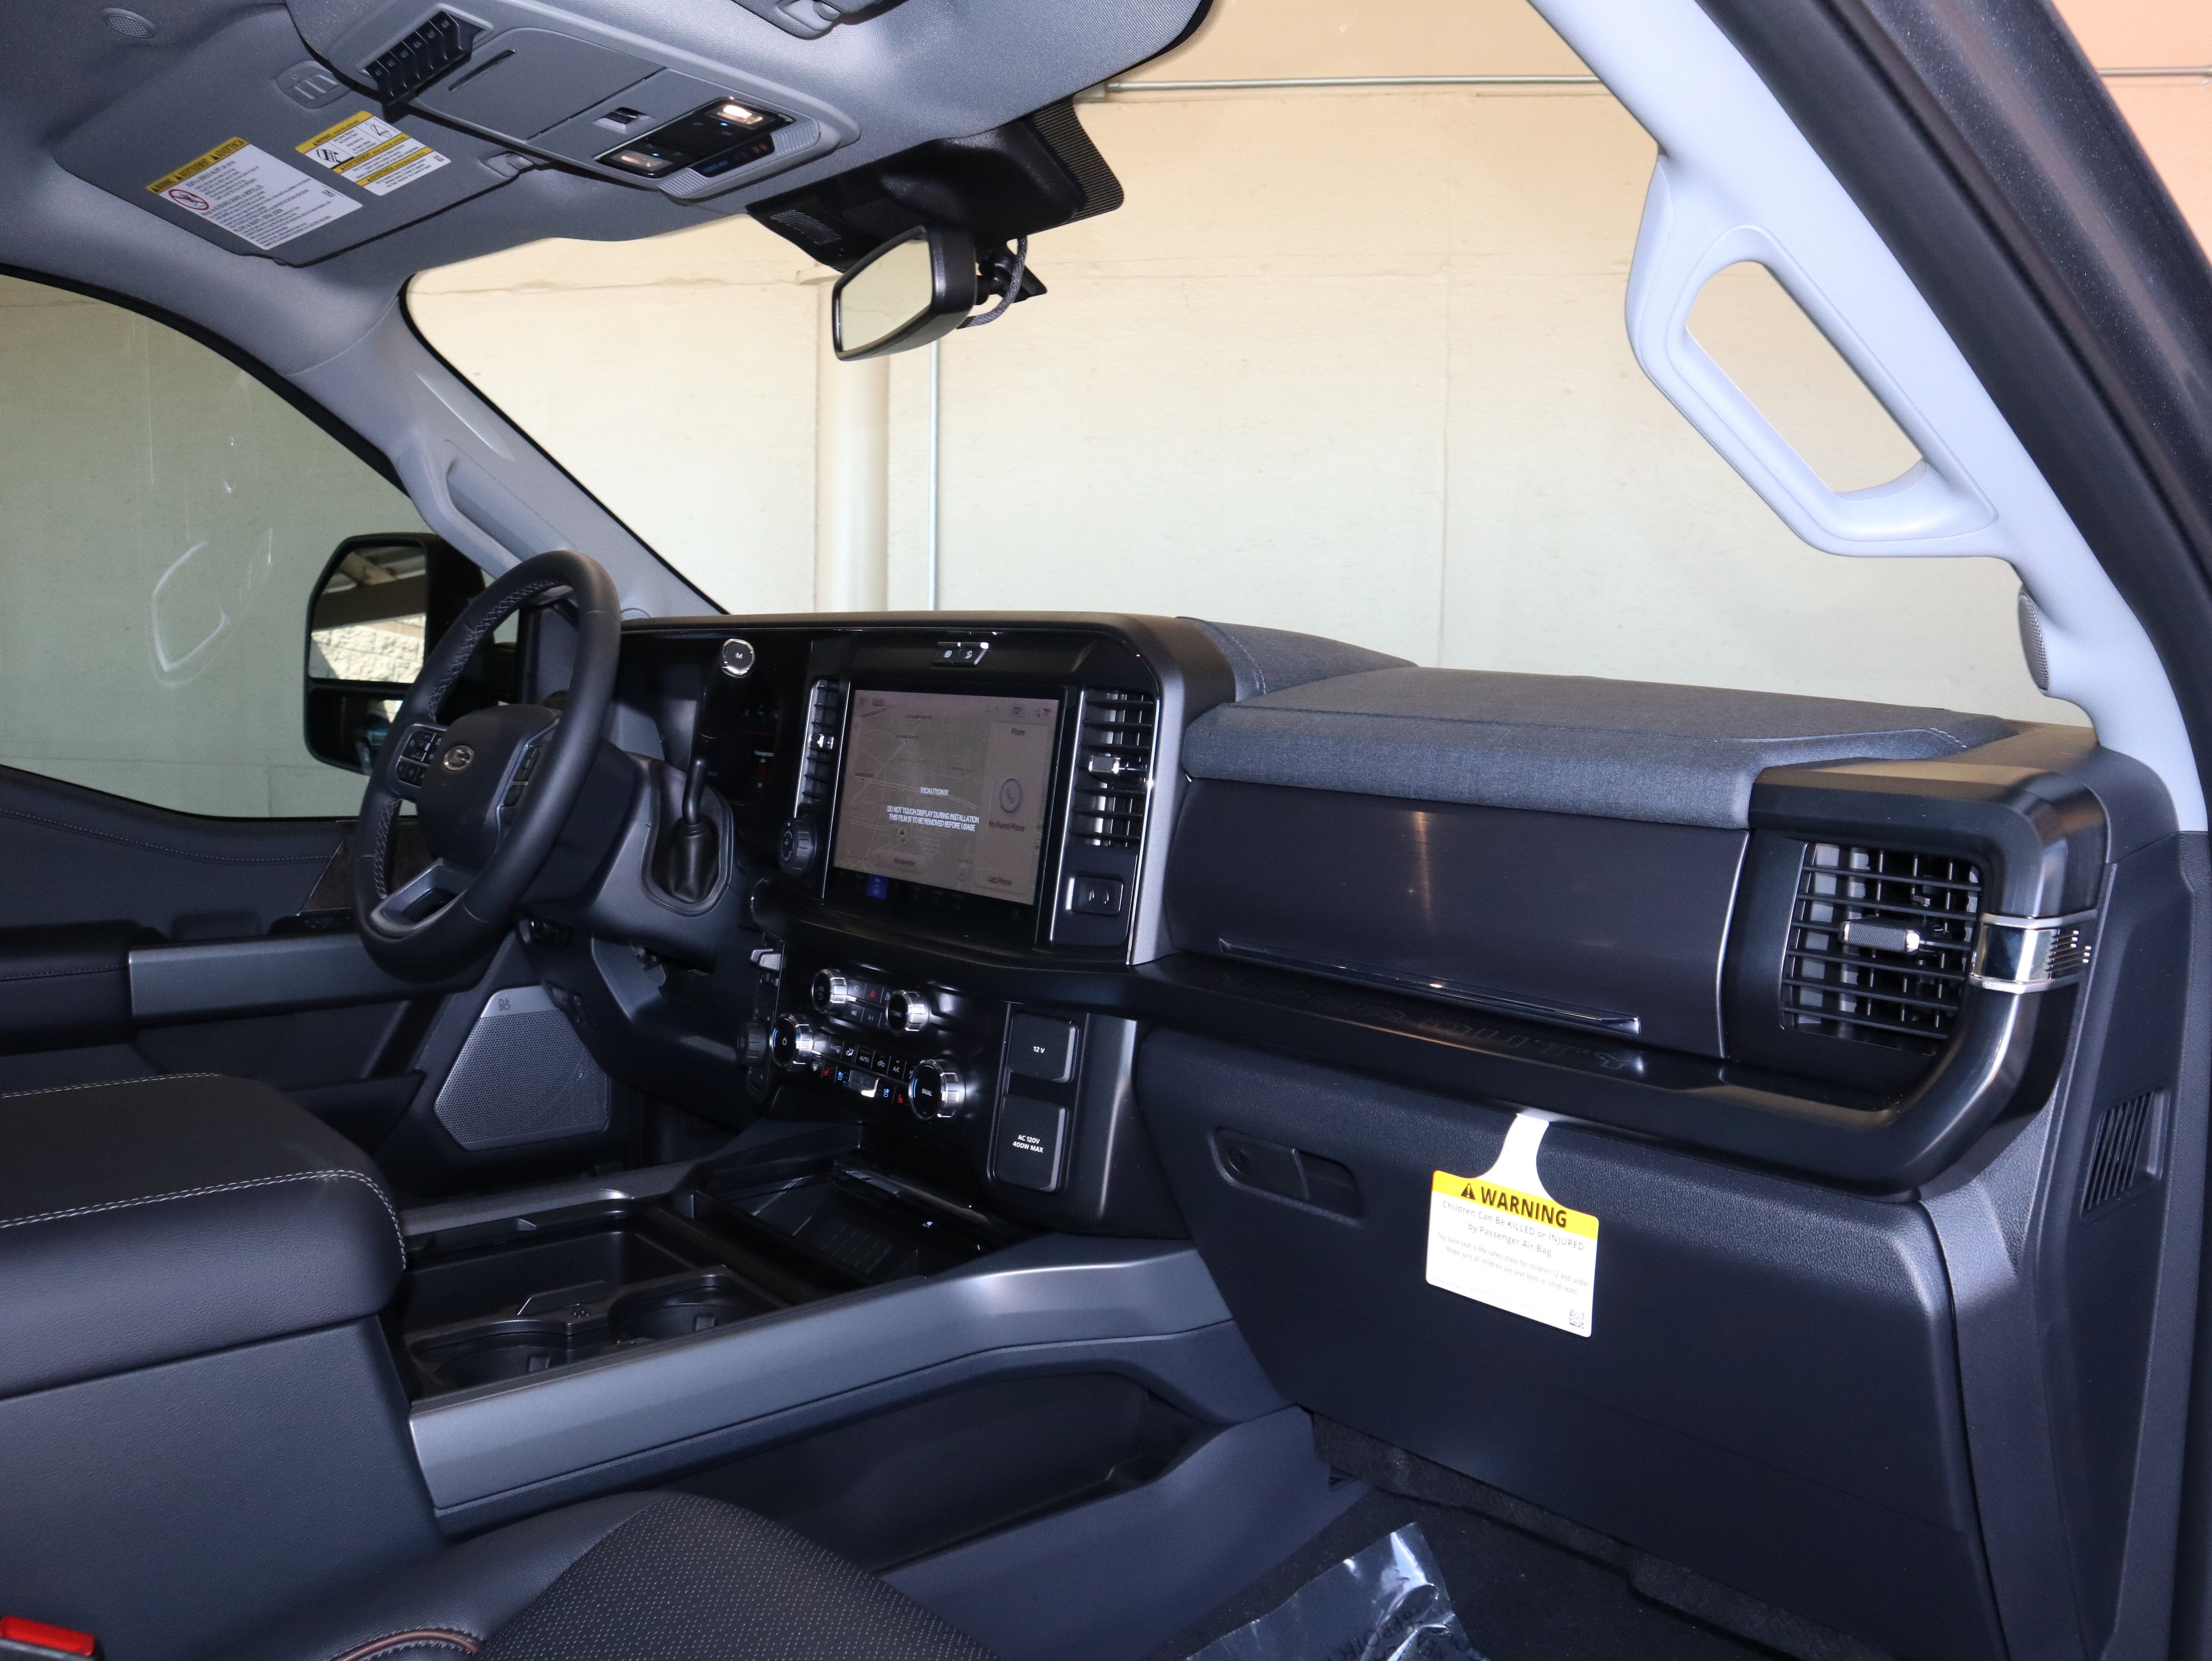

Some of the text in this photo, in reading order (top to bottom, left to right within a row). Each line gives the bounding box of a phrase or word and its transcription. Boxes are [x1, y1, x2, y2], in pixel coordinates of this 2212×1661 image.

[903, 807, 916, 816] TOUCH
[917, 809, 935, 818] DISPLAY
[934, 811, 949, 820] DURING
[950, 813, 979, 823] INSTALLATION
[924, 818, 944, 827] REMOVED
[945, 821, 961, 829] BEFORE
[961, 823, 976, 831] USAGE
[922, 1088, 932, 1097] DUAL
[1013, 1141, 1044, 1153] 400W MAX
[1026, 1136, 1040, 1144] 120V
[1480, 1186, 1566, 1228] WARNING
[1442, 1200, 1584, 1252] Children Can Be KILLED or INJURED
[1468, 1222, 1554, 1259] by Passenger Air Bag.
[1437, 1232, 1446, 1241] The
[1448, 1235, 1460, 1245] back
[1461, 1240, 1471, 1249] seat
[1478, 1245, 1487, 1254] the
[1488, 1248, 1503, 1259] safest
[1504, 1254, 1518, 1266] place
[1529, 1262, 1551, 1276] children
[1552, 1269, 1559, 1278] 12
[1560, 1272, 1571, 1282] and
[1446, 1245, 1460, 1256] Make
[1461, 1252, 1473, 1260] sure
[1481, 1257, 1502, 1270] children
[1514, 1269, 1525, 1278] seat
[1527, 1272, 1540, 1283] belts
[1548, 1279, 1561, 1290] child
